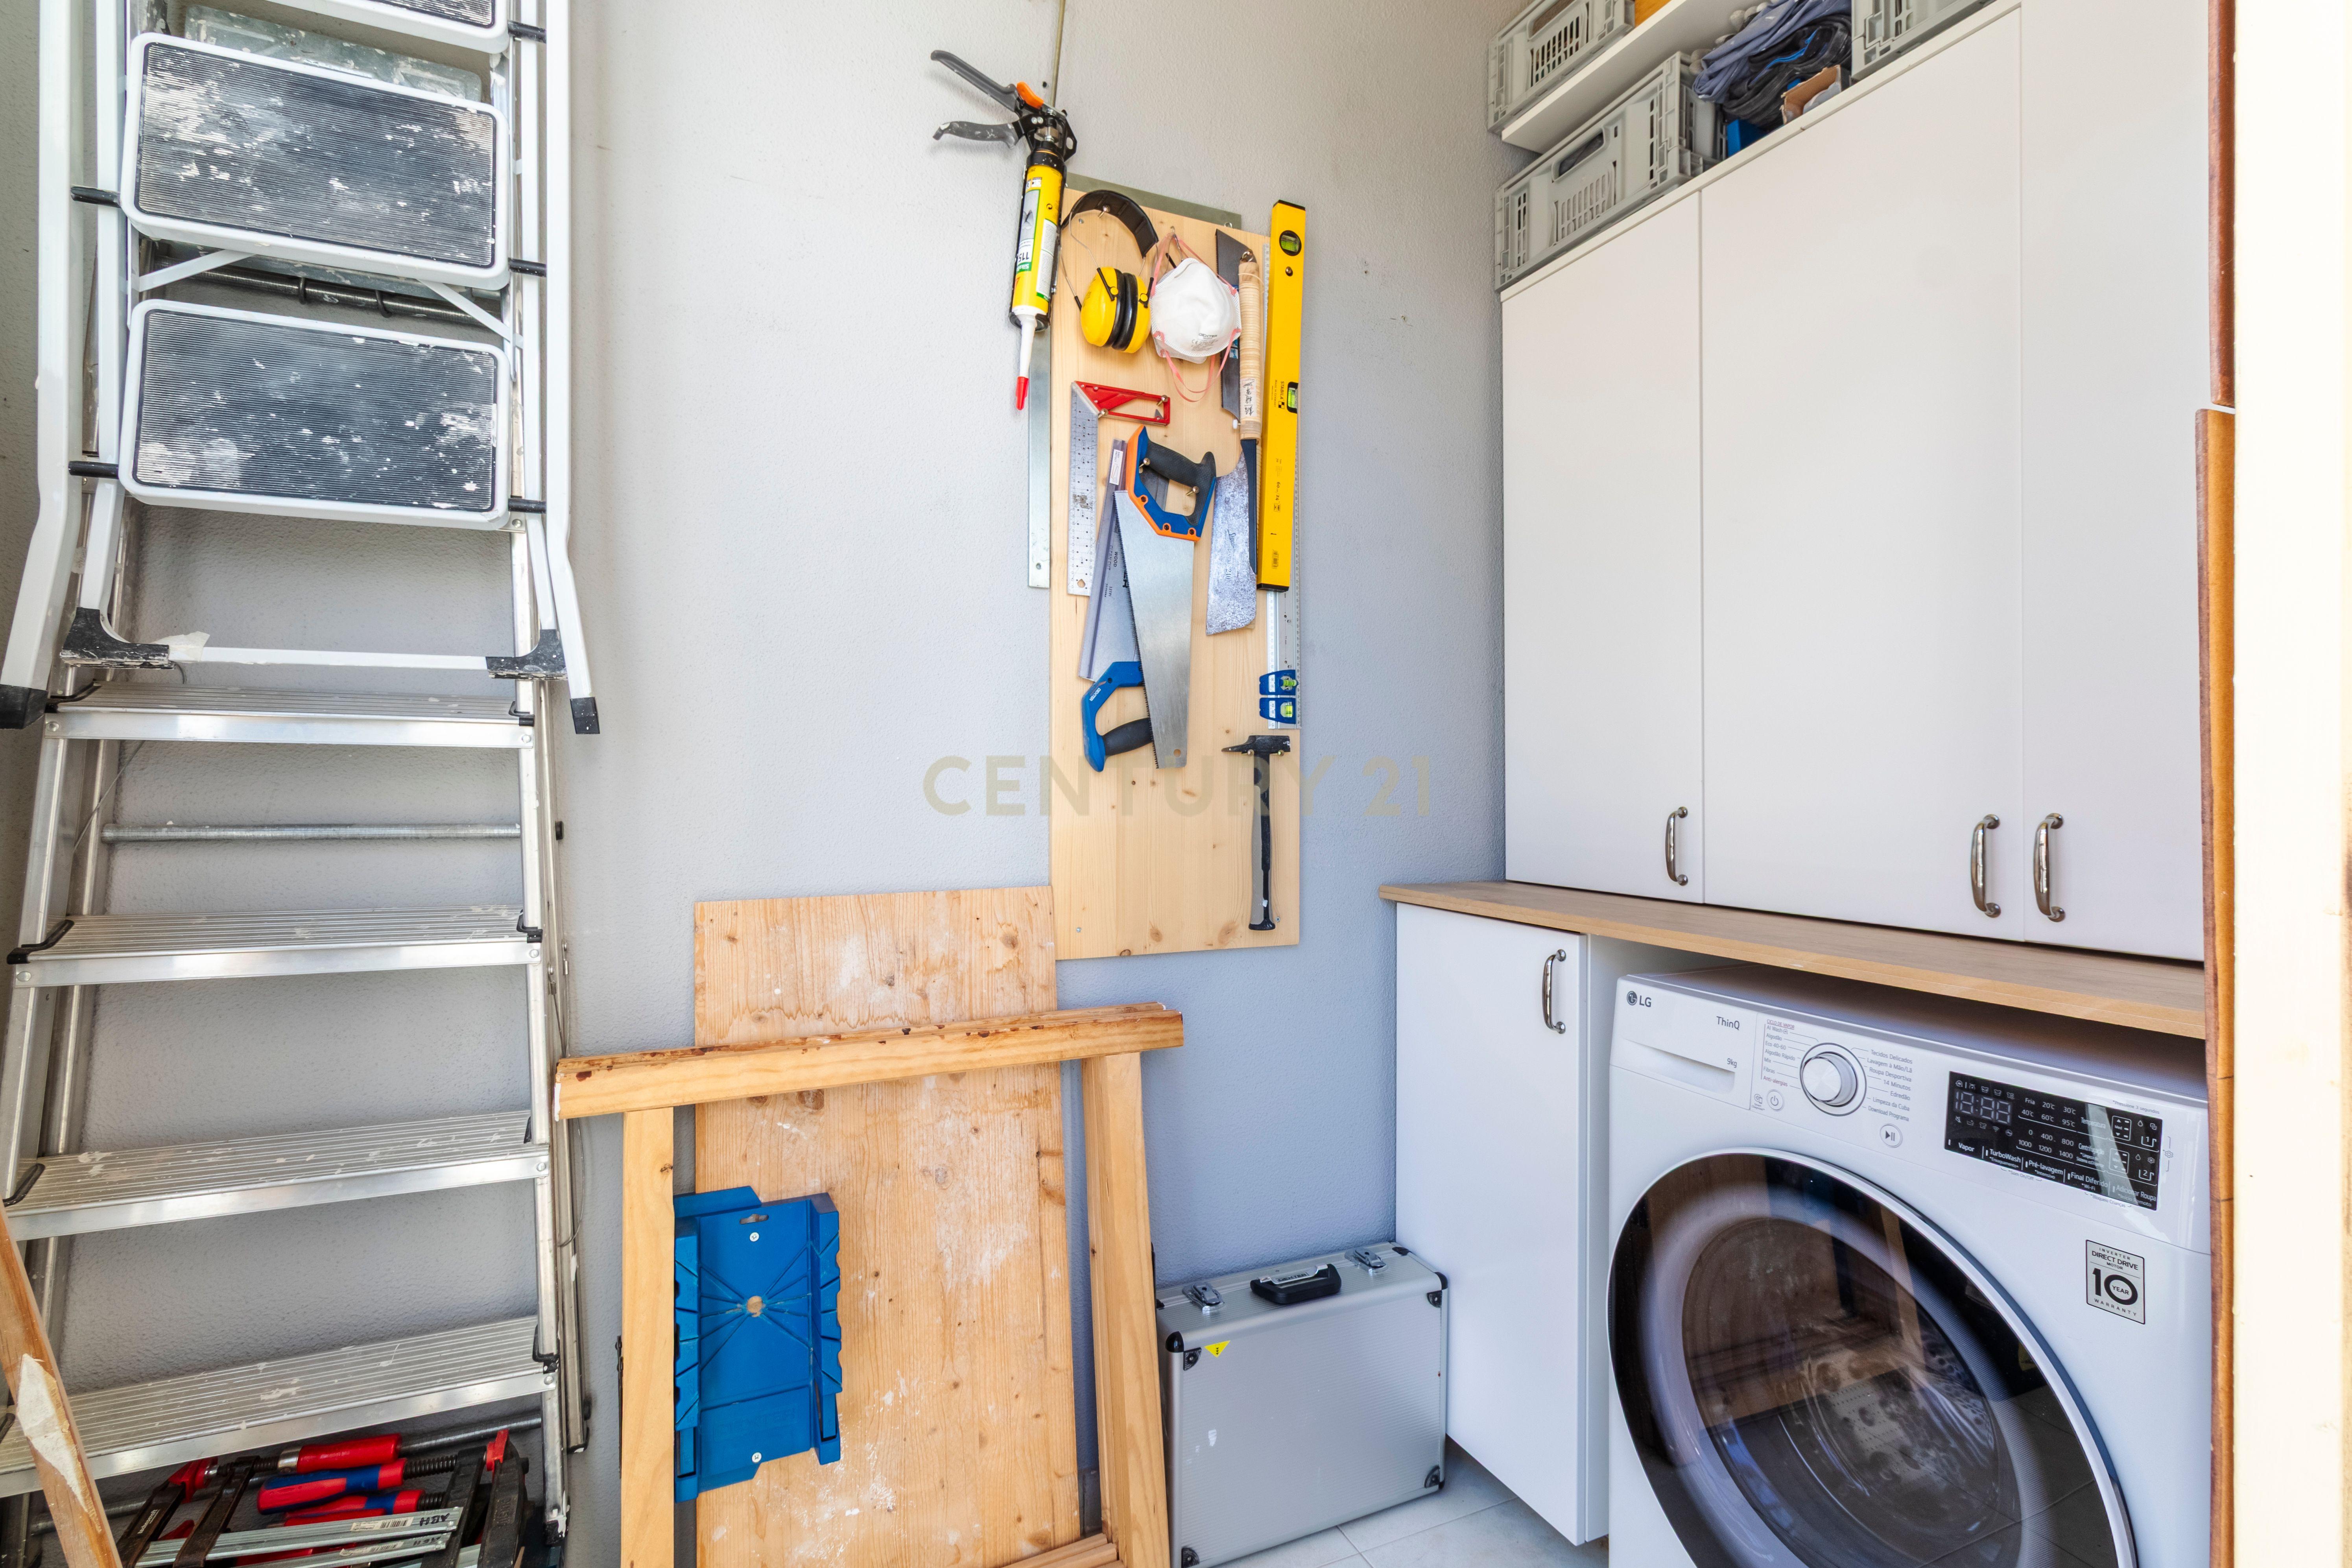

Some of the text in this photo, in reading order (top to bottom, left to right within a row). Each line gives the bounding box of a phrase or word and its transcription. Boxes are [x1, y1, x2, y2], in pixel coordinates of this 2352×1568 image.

[1639, 995, 1651, 1007] LG
[1716, 1016, 1740, 1030] ThinQ
[1727, 1058, 1737, 1068] 9kg
[1867, 1057, 1888, 1067] Lavagem
[1871, 1049, 1913, 1064] Tecidos Delicados
[1763, 1075, 1788, 1087] Anti-alergias
[1869, 1067, 1912, 1082] Roupa Desportiva
[1891, 1081, 1911, 1091] Minutos
[1872, 1097, 1891, 1106] Limpeza
[1890, 1091, 1910, 1101] Edredão
[1868, 1105, 1909, 1122] Download Programa
[2081, 1117, 2106, 1129] Temperatura
[1958, 1142, 1975, 1152] Vapor
[2018, 1139, 2032, 1147] 1000
[2038, 1145, 2052, 1153] 1200
[2059, 1150, 2073, 1159] 1400
[1989, 1149, 2021, 1163] TurboWash
[2029, 1160, 2063, 1175] Pré-lavagem
[2071, 1172, 2108, 1188] Final Diferido
[2116, 1185, 2157, 1201] Adicionar Roupa
[2099, 1247, 2131, 1260] INVERTER
[2092, 1251, 2138, 1270] DIRECT DRIVE
[1278, 1273, 1307, 1282] DEXTER
[2092, 1267, 2138, 1305] 10
[2112, 1285, 2129, 1295] YEAR
[2094, 1298, 2137, 1316] WARRANTY
